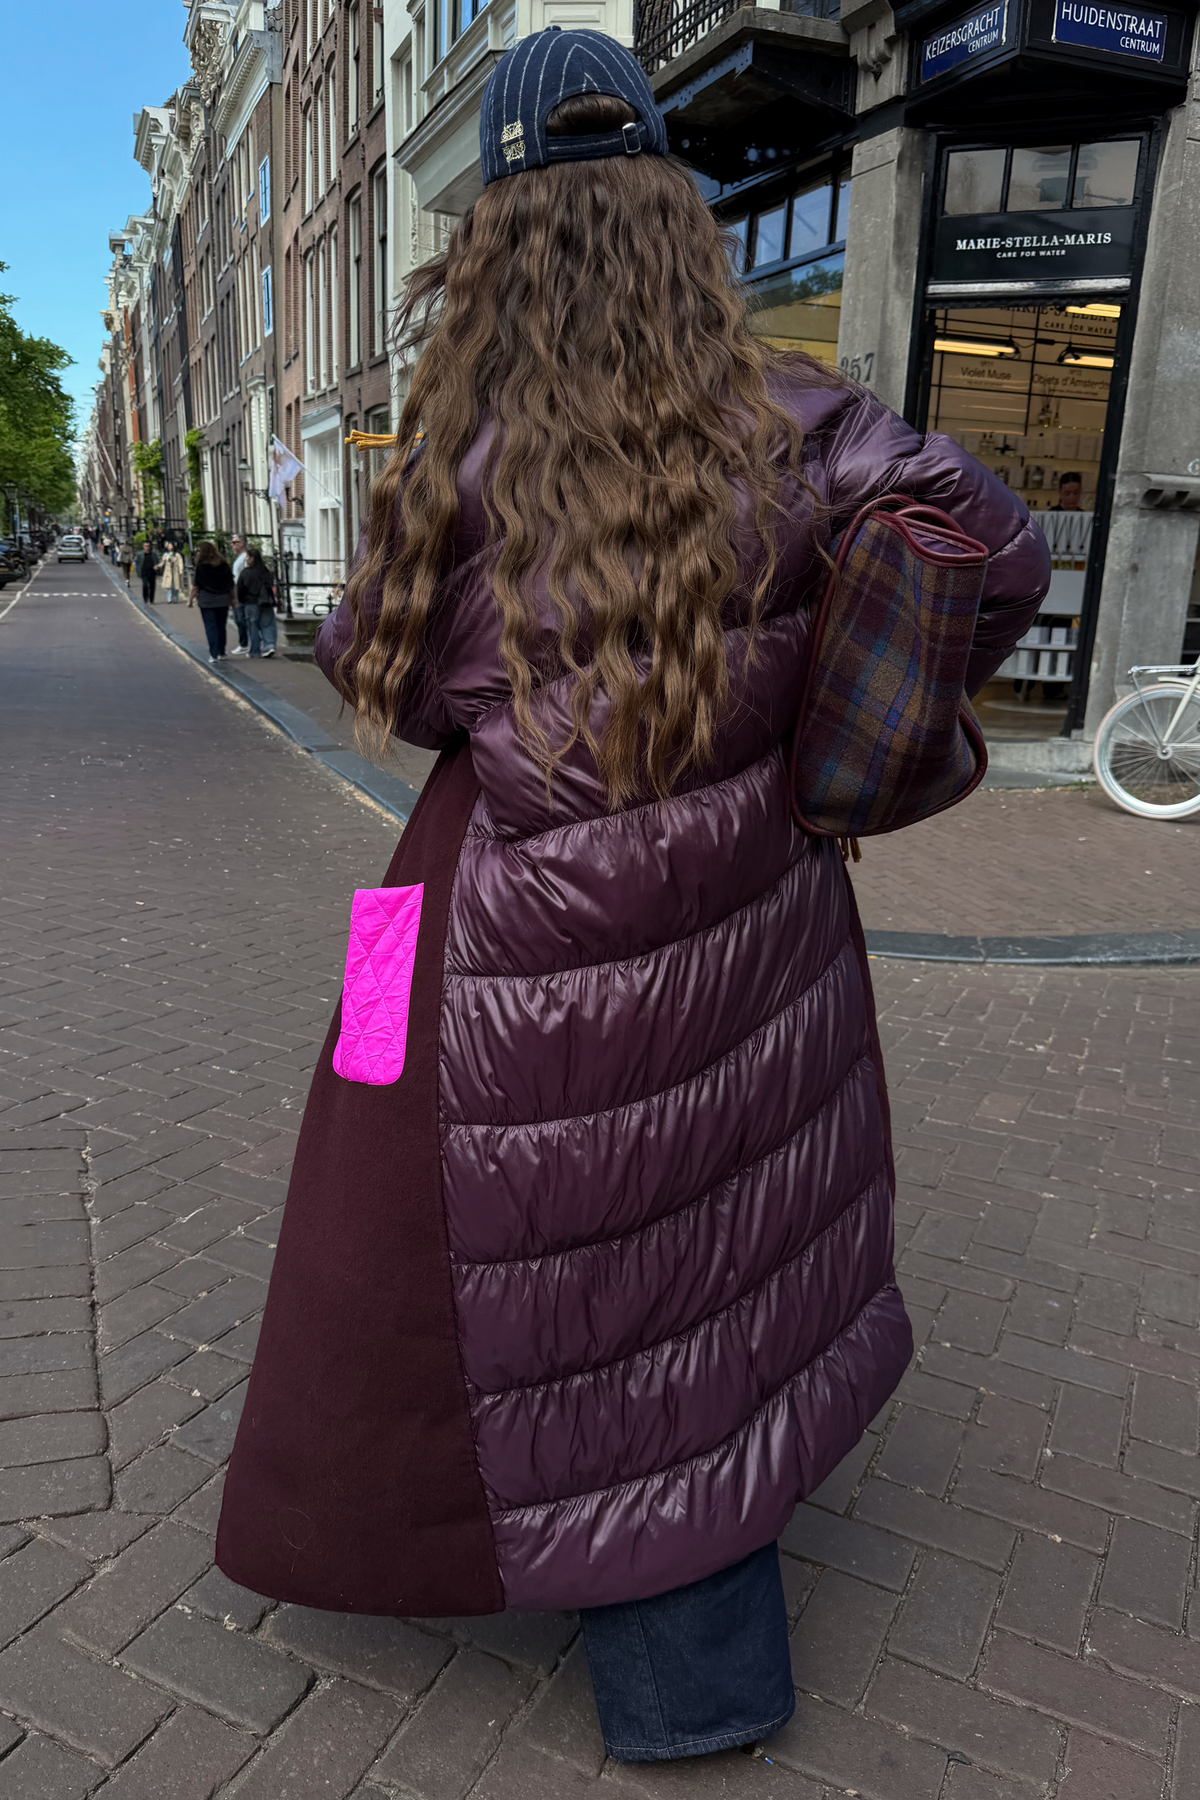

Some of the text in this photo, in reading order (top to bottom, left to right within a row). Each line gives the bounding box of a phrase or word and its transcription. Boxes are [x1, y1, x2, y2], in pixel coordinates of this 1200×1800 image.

[1061, 1, 1163, 39] HUIDENSTRAAT
[925, 6, 1001, 62] KEIZERSGRACHT
[967, 28, 999, 54] CENTRUM
[1119, 36, 1161, 55] CENTRUM
[955, 232, 1112, 251] MARIE-STELLA-MARIS
[996, 249, 1066, 259] CARE FOR WATER
[1044, 321, 1065, 330] CARE
[1087, 326, 1114, 335] WATER
[961, 366, 1012, 380] Violet Muse
[1061, 375, 1109, 390] d'Amsterda
